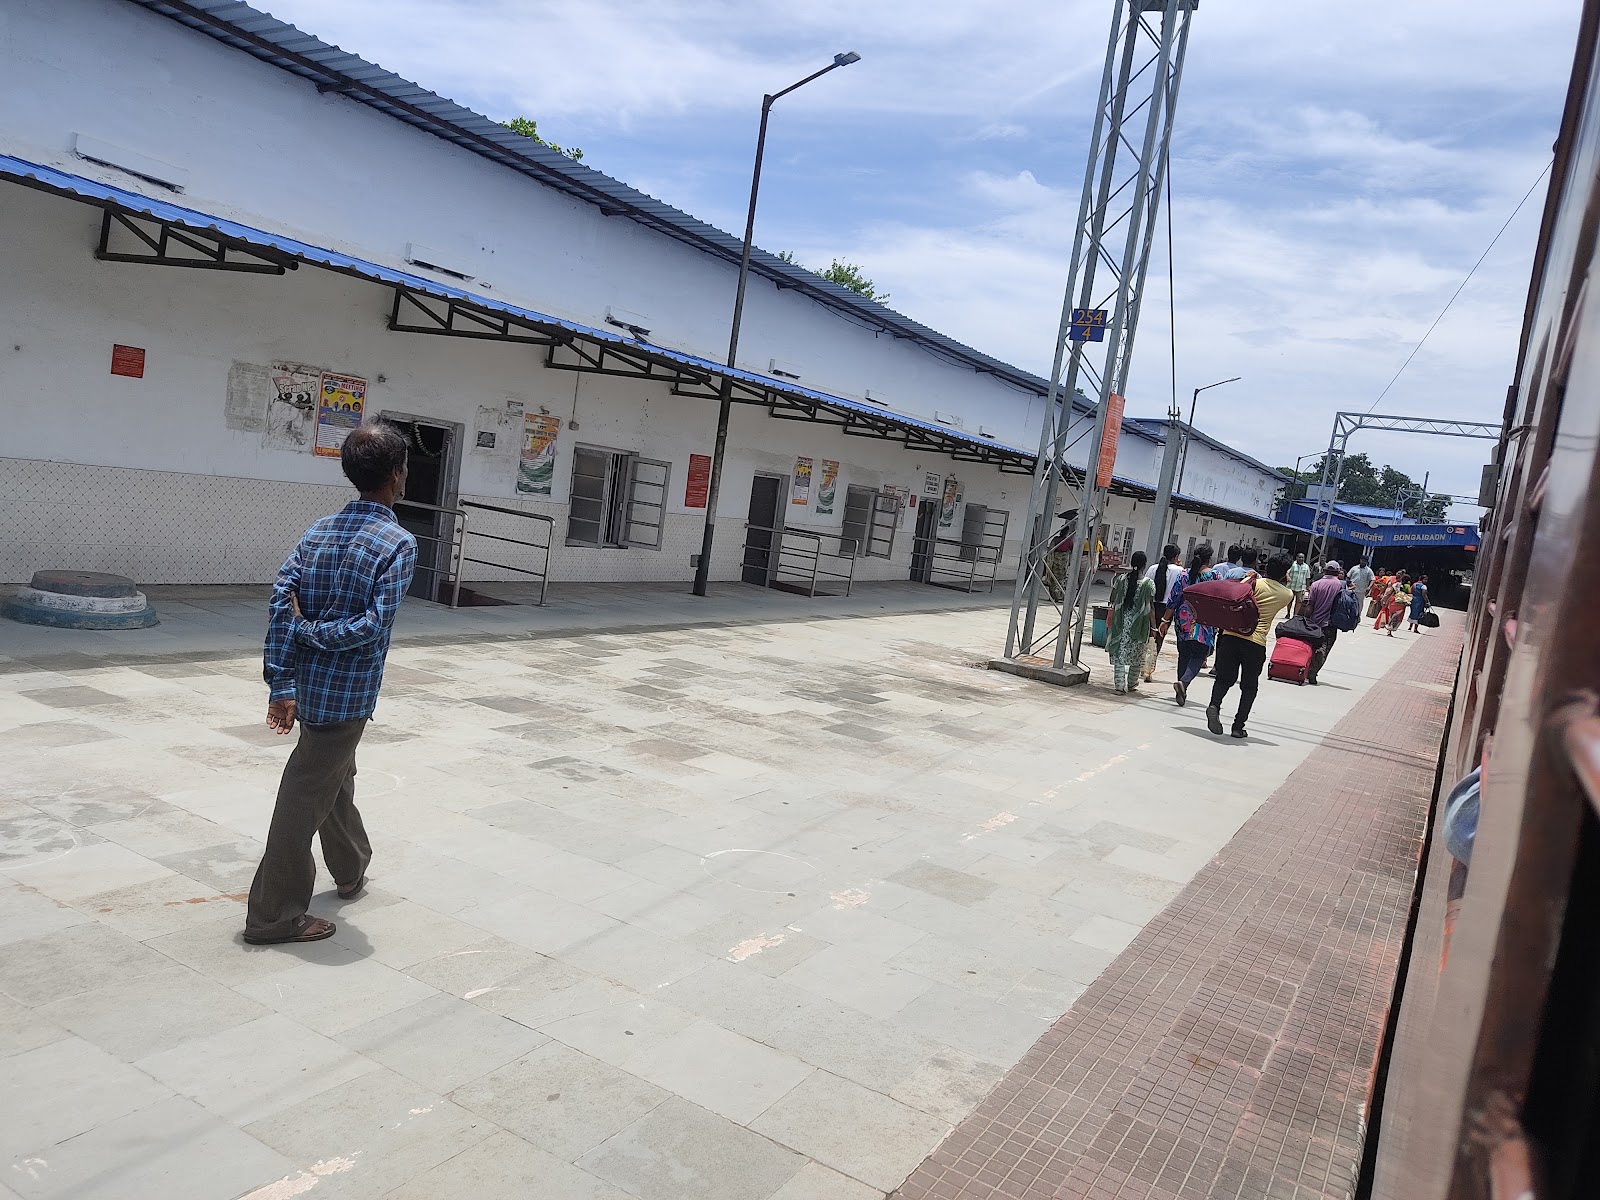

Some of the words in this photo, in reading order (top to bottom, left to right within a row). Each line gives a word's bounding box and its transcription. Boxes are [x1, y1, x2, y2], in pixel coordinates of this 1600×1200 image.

[1076, 310, 1103, 324] 254
[1081, 326, 1091, 340] 4
[341, 383, 365, 393] MEETING
